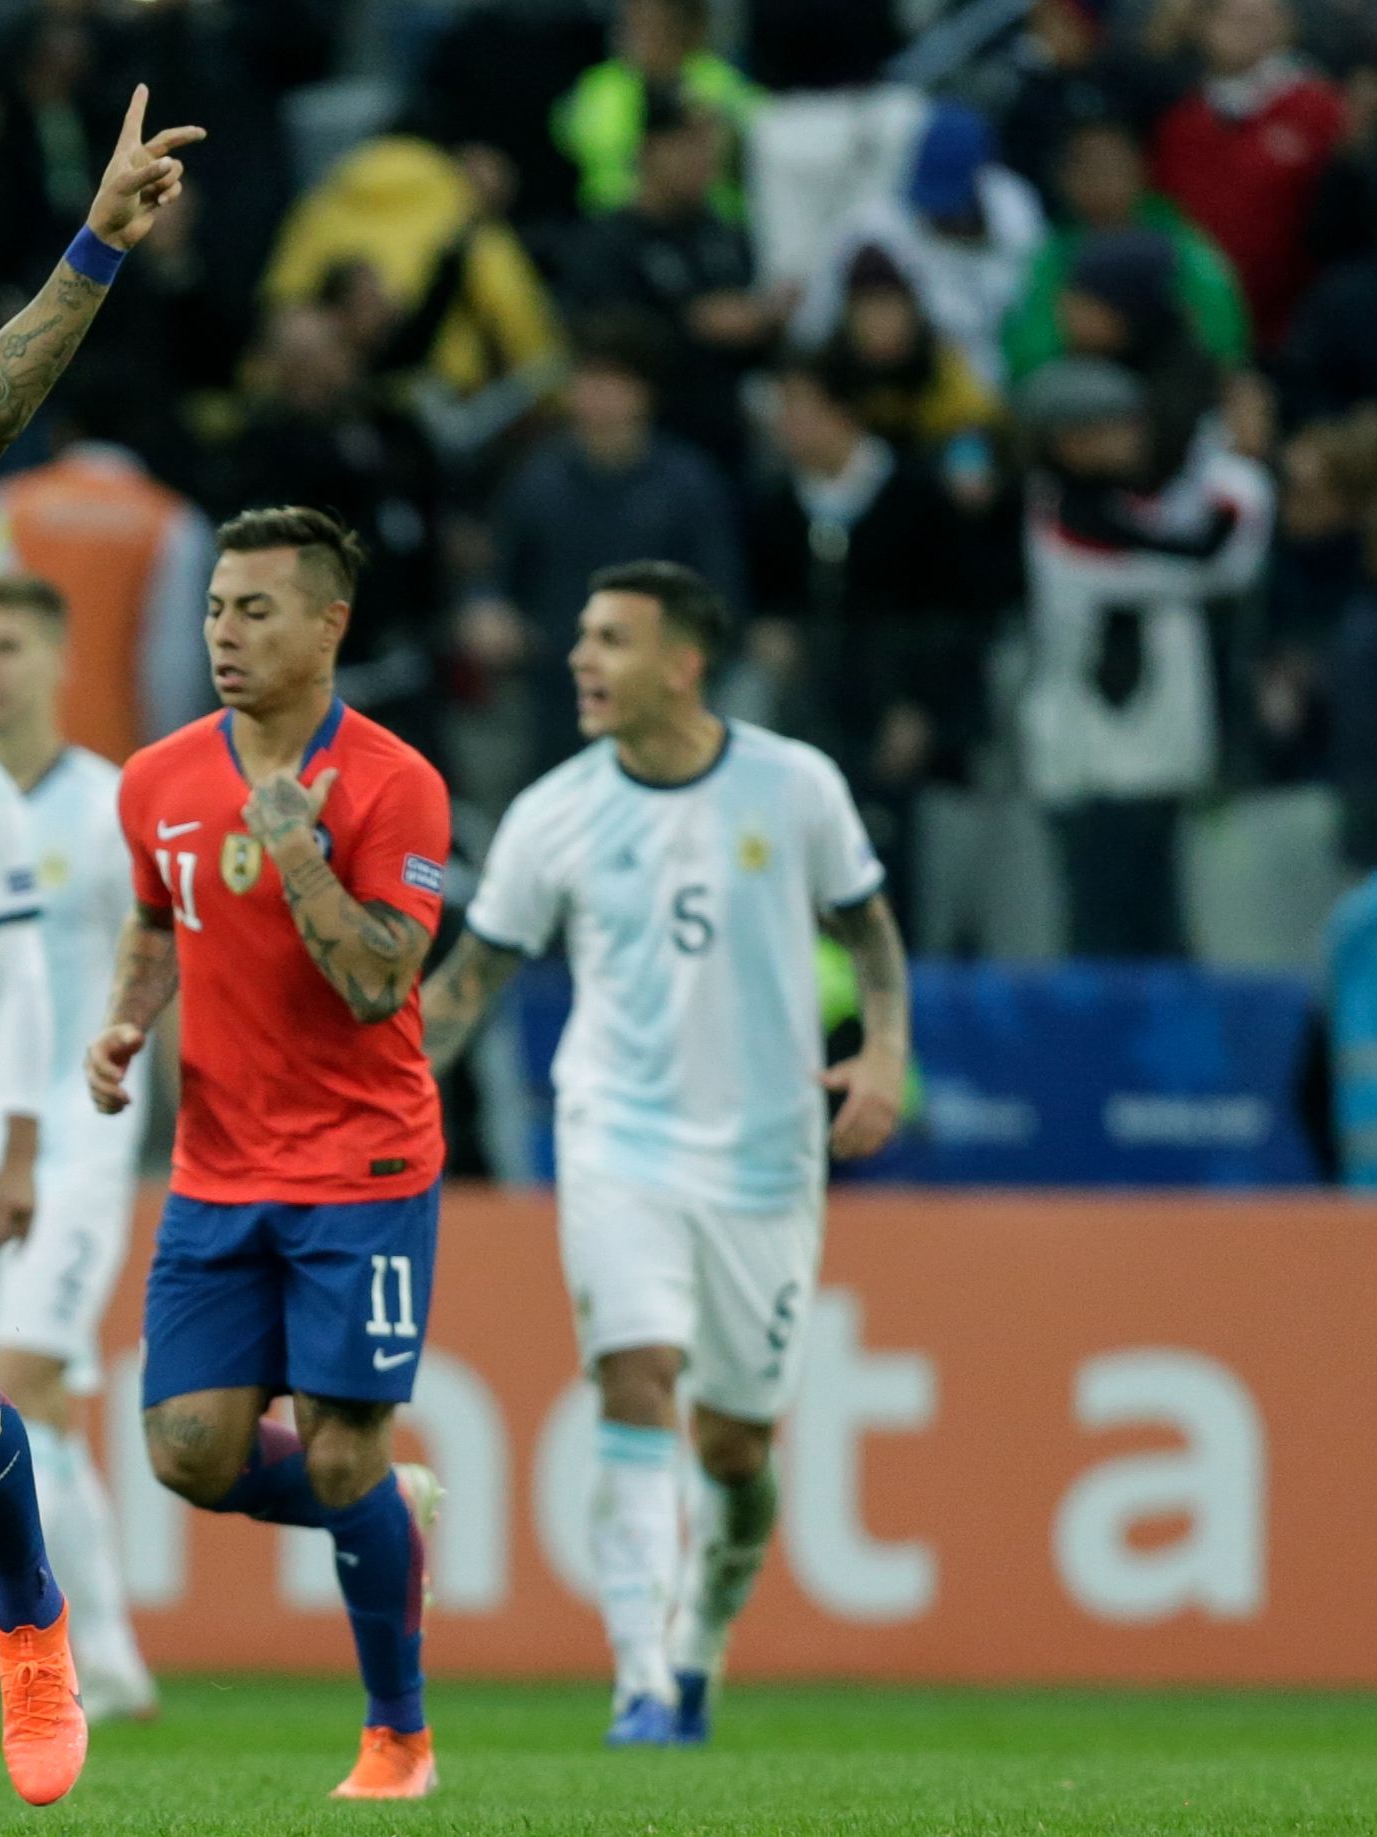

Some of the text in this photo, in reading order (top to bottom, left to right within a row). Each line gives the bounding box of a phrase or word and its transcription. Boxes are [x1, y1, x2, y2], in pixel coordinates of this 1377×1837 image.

[155, 848, 204, 933] 11
[672, 883, 715, 957] 5
[366, 1255, 418, 1338] 11
